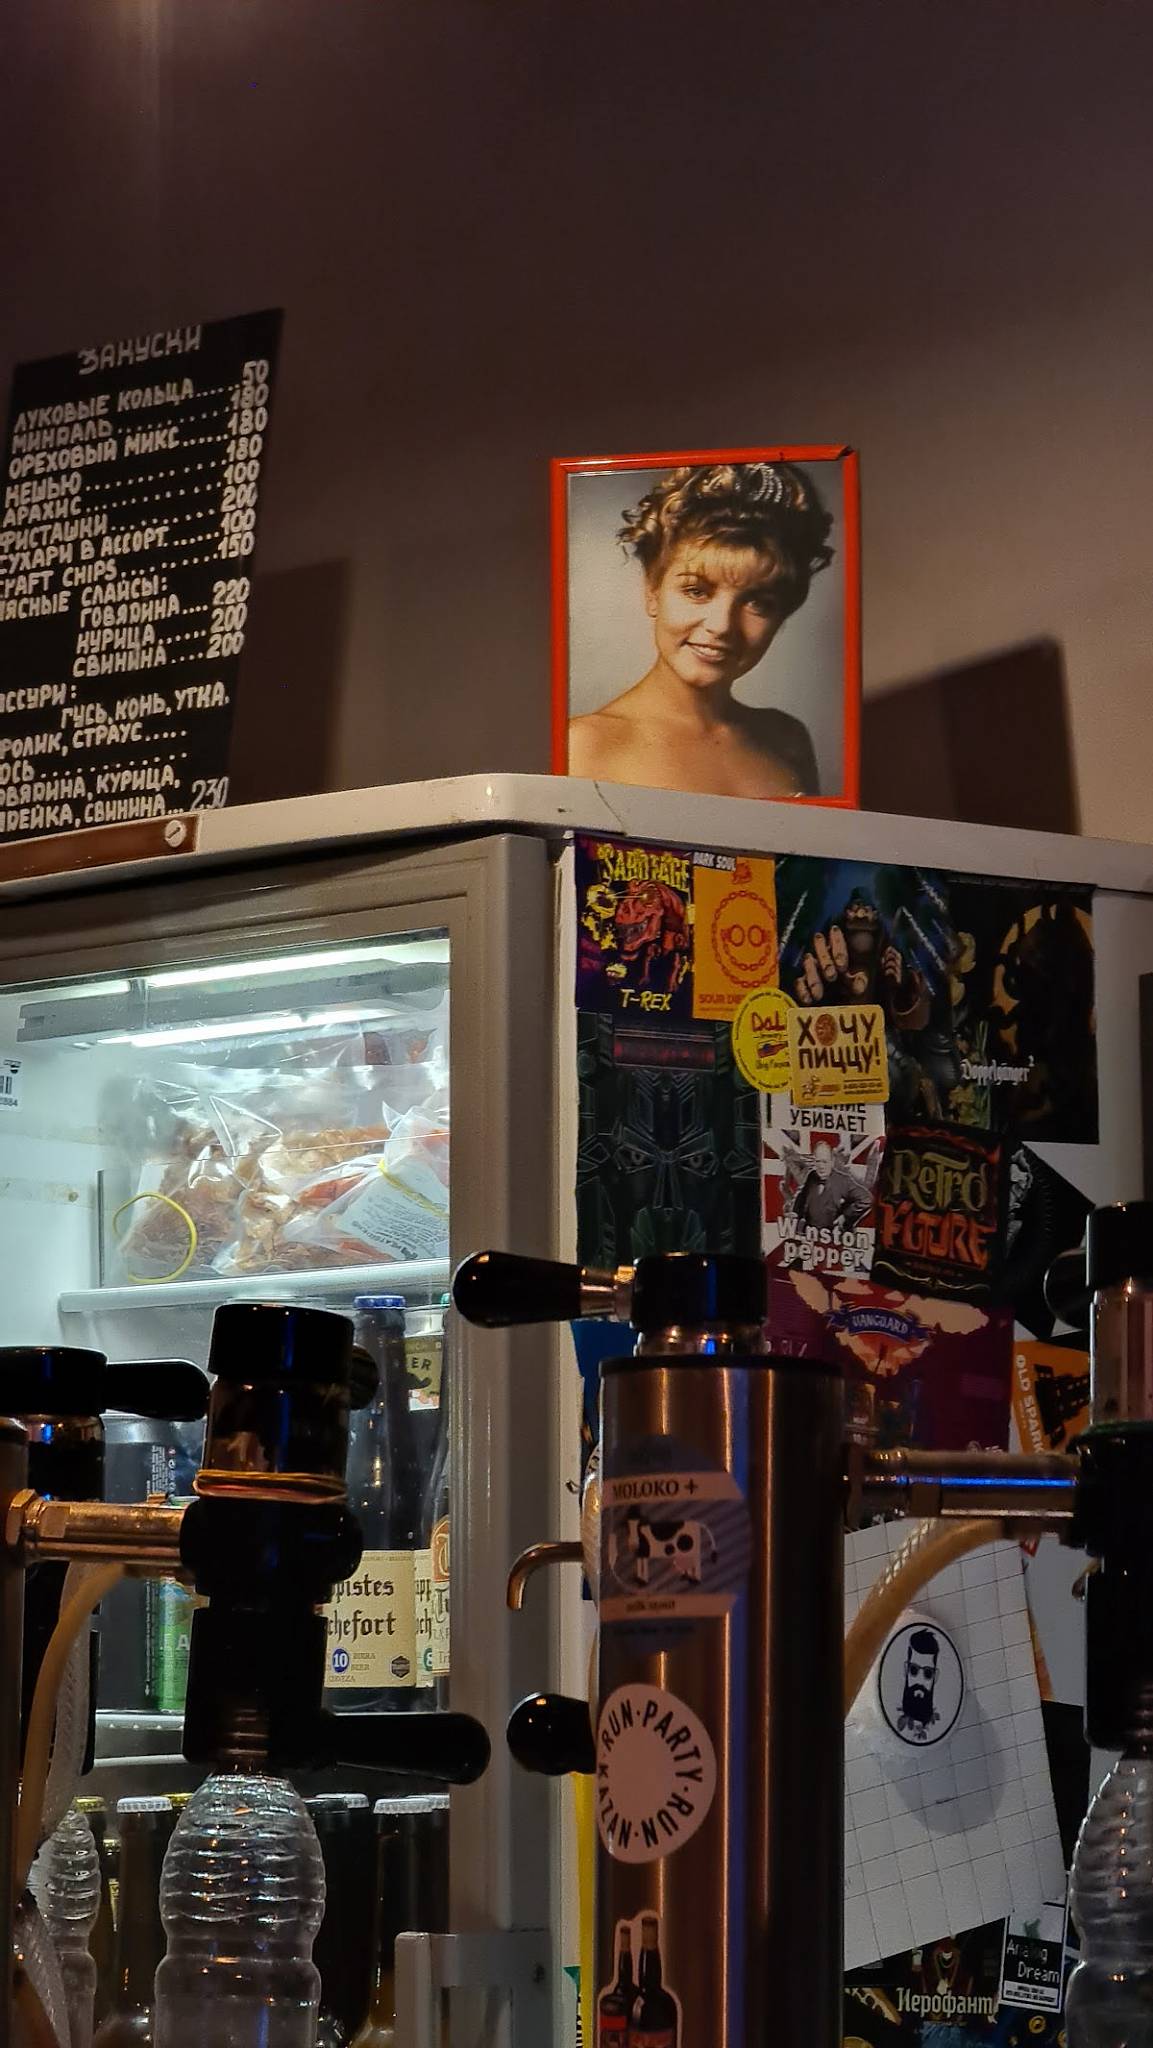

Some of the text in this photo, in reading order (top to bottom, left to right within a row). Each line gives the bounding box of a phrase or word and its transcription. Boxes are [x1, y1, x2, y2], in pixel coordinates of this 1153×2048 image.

[13, 359, 269, 433] ЛУКОВЫЕ КОЛЬЦА 50
[9, 407, 268, 480] ОРЕХОВЫЙ МИКС 180
[12, 419, 113, 455] МИНДАЛЬ
[226, 433, 263, 463] 180
[2, 459, 260, 528] АРАХИС 100
[221, 482, 258, 513] 200
[80, 539, 96, 560] В
[220, 508, 256, 536] 100
[62, 558, 118, 587] CHIPS
[217, 531, 255, 560] 150
[79, 576, 250, 629] ГОВЯДИНА 220
[210, 602, 248, 634] 200
[72, 631, 245, 678] СВИНИНА 200
[72, 722, 143, 749] СТРАУС
[84, 793, 165, 824] СВИНИНА
[190, 776, 229, 812] 230
[620, 989, 672, 1011] T-REX
[799, 1038, 880, 1075] ПИЦЦУ!
[791, 1110, 867, 1133] УБИВАЕТ
[890, 1149, 988, 1212] Retro
[879, 1200, 997, 1271] FUTURE
[783, 1240, 867, 1269] pepper
[851, 1313, 910, 1335] VANGUARD
[1015, 1354, 1031, 1392] OLD
[333, 1652, 348, 1668] 10
[598, 1699, 703, 1850] RUN PARTY RUN KAZAN
[1017, 1961, 1060, 1984] Dream
[896, 1987, 994, 2017] Иерофант
